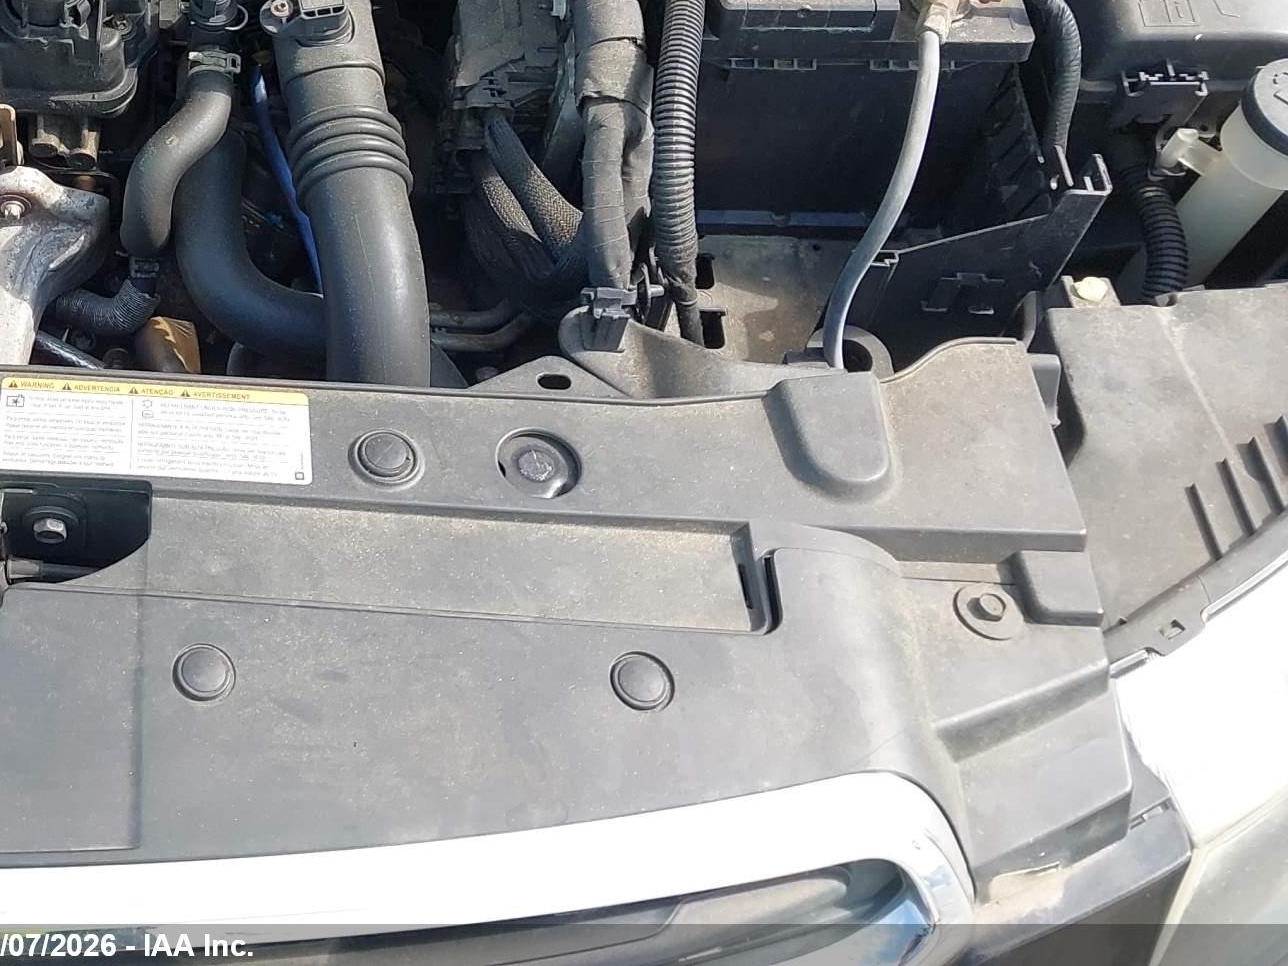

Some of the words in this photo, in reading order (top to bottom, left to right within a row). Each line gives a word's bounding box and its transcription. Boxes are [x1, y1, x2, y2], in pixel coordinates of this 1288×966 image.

[20, 380, 55, 389] WARNING
[74, 384, 120, 393] ADVERTENCIA
[140, 387, 174, 396] ATENÇÃO
[193, 391, 251, 400] AVERTISSEMENT
